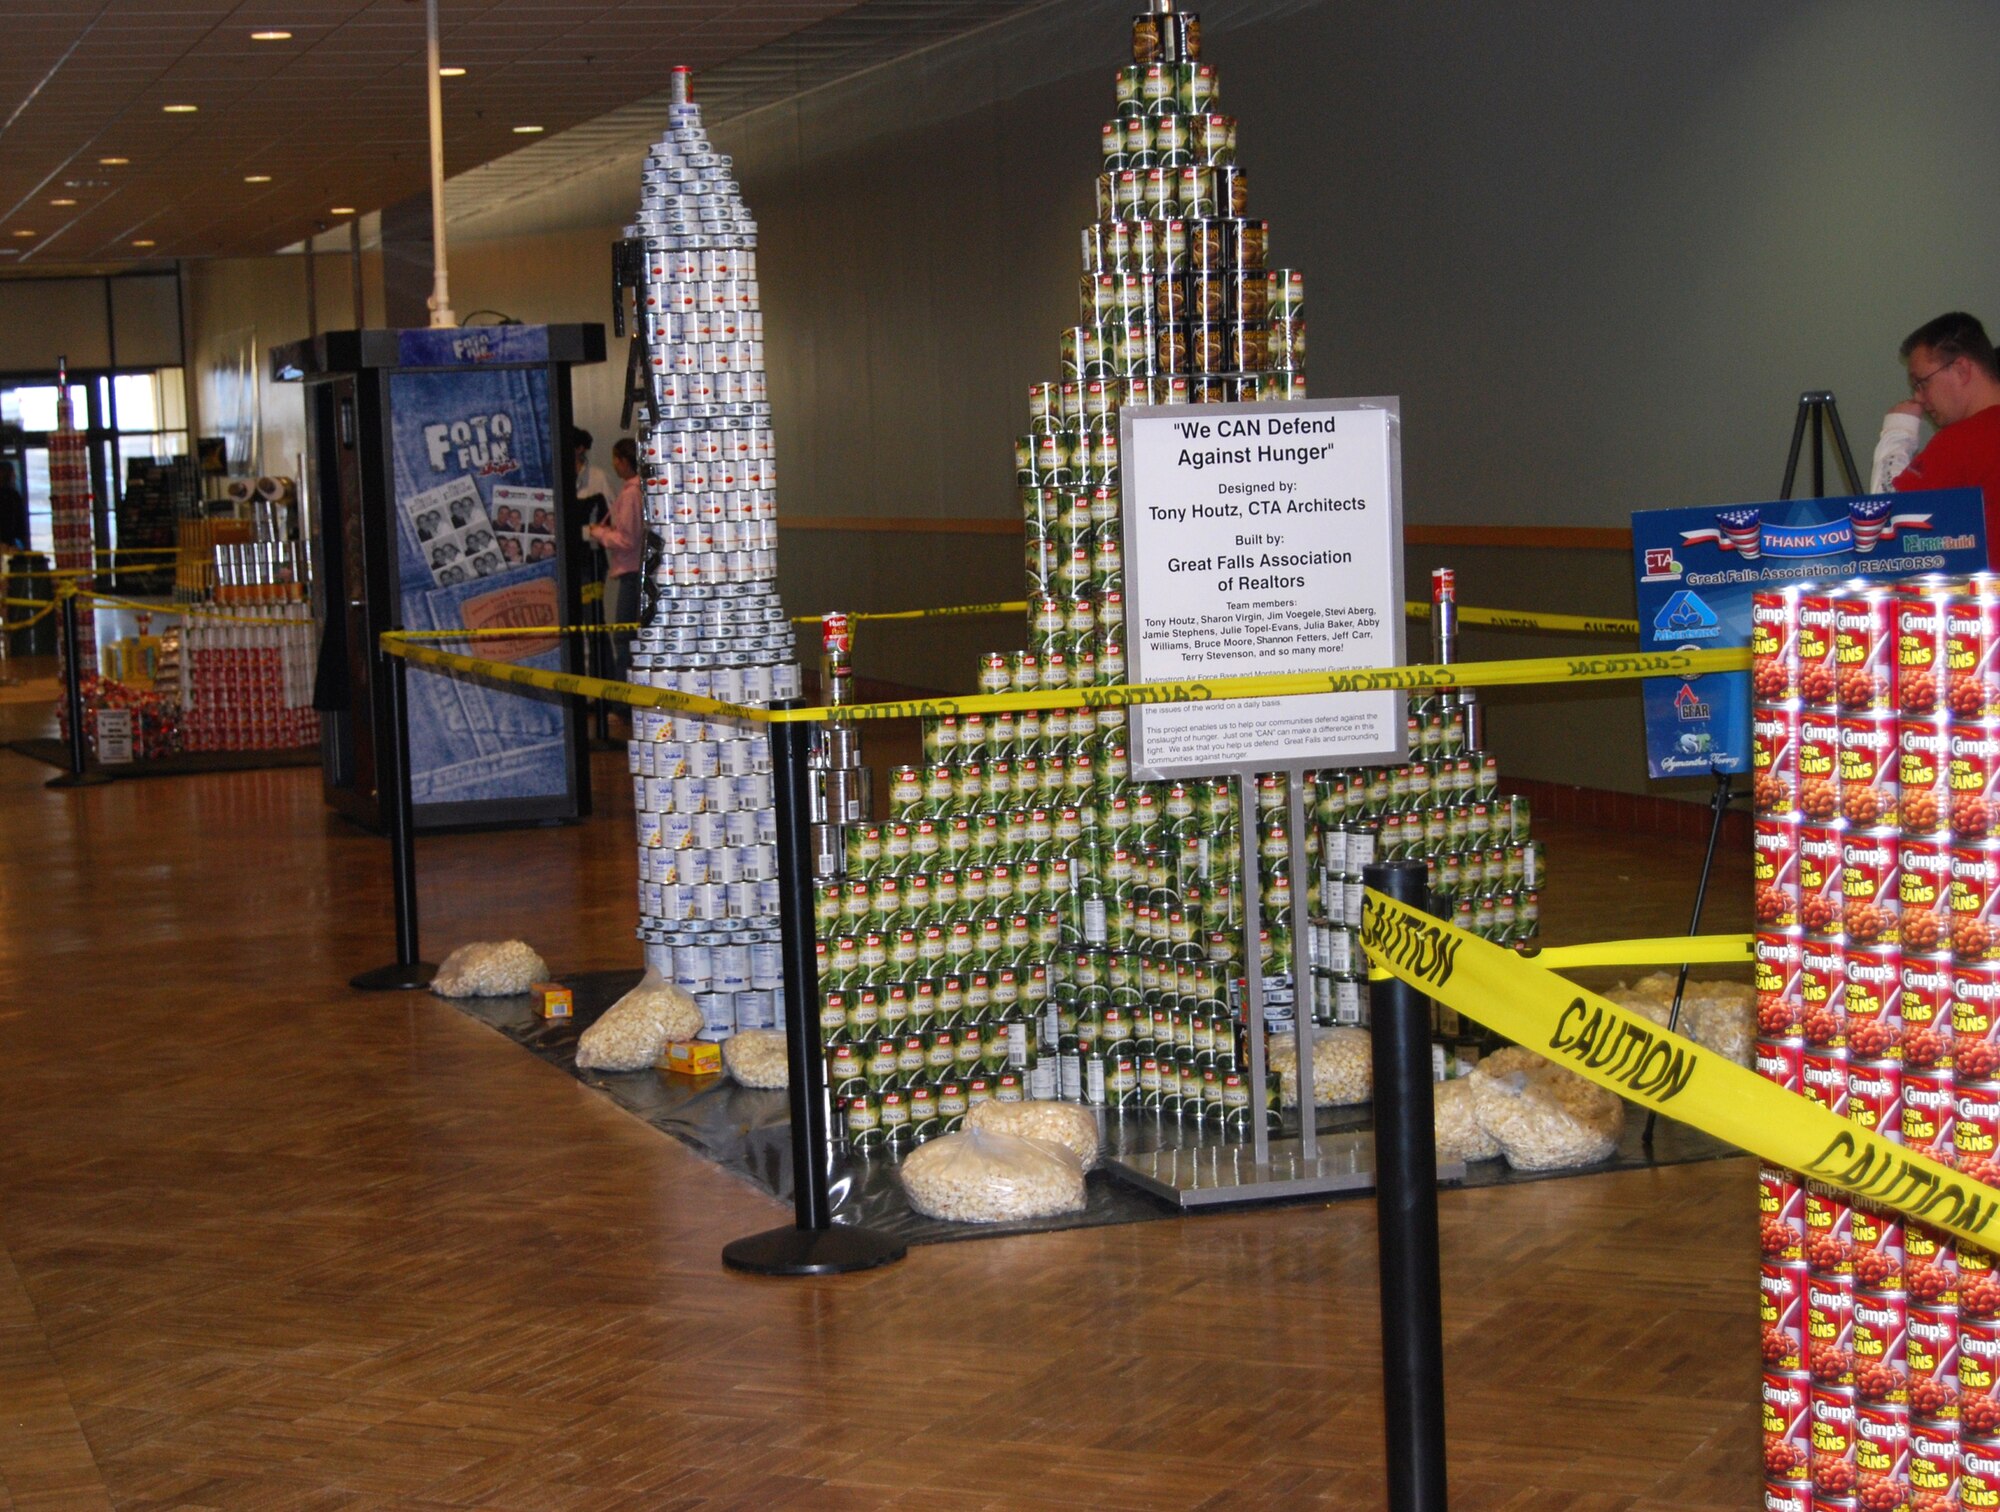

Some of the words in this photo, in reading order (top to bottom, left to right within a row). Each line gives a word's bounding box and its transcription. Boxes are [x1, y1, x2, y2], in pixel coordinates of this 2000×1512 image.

[1174, 422, 1210, 439] "We
[1218, 419, 1260, 437] CAN
[1268, 416, 1335, 435] Defend
[424, 413, 512, 472] FOTO
[458, 442, 510, 469] FUN
[1178, 447, 1251, 469] Against
[1258, 443, 1334, 465] Hunger"
[1219, 481, 1275, 496] Designed
[1279, 481, 1296, 494] by:
[1149, 506, 1186, 522] Tony
[1192, 504, 1242, 518] Houtz,
[1248, 501, 1281, 515] CTA
[1287, 497, 1365, 513] Architects
[1236, 534, 1262, 545] Built
[1266, 534, 1284, 546] by:
[1763, 534, 1816, 548] THANK
[1819, 530, 1850, 543] YOU
[1168, 558, 1212, 572] Great
[1218, 555, 1254, 569] Falls
[1260, 550, 1351, 567] Association
[1645, 553, 1672, 568] CTA
[1218, 577, 1233, 591] of
[1239, 575, 1305, 590] Realtors
[1687, 572, 1724, 586] Great
[1727, 570, 1758, 582] Falls
[1761, 564, 1840, 580] Association
[1842, 561, 1856, 573] of
[1226, 602, 1250, 610] Team
[1253, 600, 1296, 608] members:
[1145, 618, 1166, 628] Tony
[1201, 615, 1233, 624] Sharon
[1235, 613, 1264, 623] Virgin,
[1286, 609, 1324, 620] Voegele,
[1325, 608, 1346, 617] Stevi
[1348, 607, 1376, 616] Aberg,
[1142, 631, 1169, 639] Jamie
[1172, 629, 1217, 638] Stephens,
[1220, 626, 1242, 635] Julie
[1244, 623, 1301, 634] Topel-Evans,
[1304, 621, 1325, 630] Julia
[1328, 620, 1354, 628] Baker,
[1357, 618, 1380, 627] Abby
[1653, 627, 1718, 641] Albertsons
[1150, 642, 1191, 650] Williams,
[1194, 640, 1221, 648] Bruce
[1257, 636, 1293, 644] Shannon
[1297, 634, 1329, 642] Fetters,
[1332, 631, 1349, 640] Jeff
[1352, 630, 1373, 639] Carr,
[1181, 653, 1203, 662] Terry
[1207, 651, 1256, 660] Stevenson,
[1259, 648, 1275, 656] and
[1319, 643, 1343, 653] more!
[1682, 704, 1709, 718] GFAR
[1163, 726, 1187, 734] project
[1269, 718, 1313, 726] communities
[1340, 714, 1365, 723] against
[1255, 729, 1276, 737] "CAN"
[1147, 747, 1163, 755] fight.
[1337, 733, 1379, 742] surrounding
[1842, 728, 1889, 749] Camp's
[1952, 736, 1999, 759] Camp's
[1148, 756, 1193, 764] communities
[1194, 753, 1220, 762] against
[1360, 894, 1462, 988] CAUTION
[1848, 961, 1894, 983] Camp's
[1904, 969, 1948, 991] Camp's
[1549, 997, 1697, 1102] CAUTION
[1804, 1132, 1998, 1232] CAUTION
[1859, 1418, 1906, 1441] Camp's
[1911, 1458, 1936, 1472] PORK
